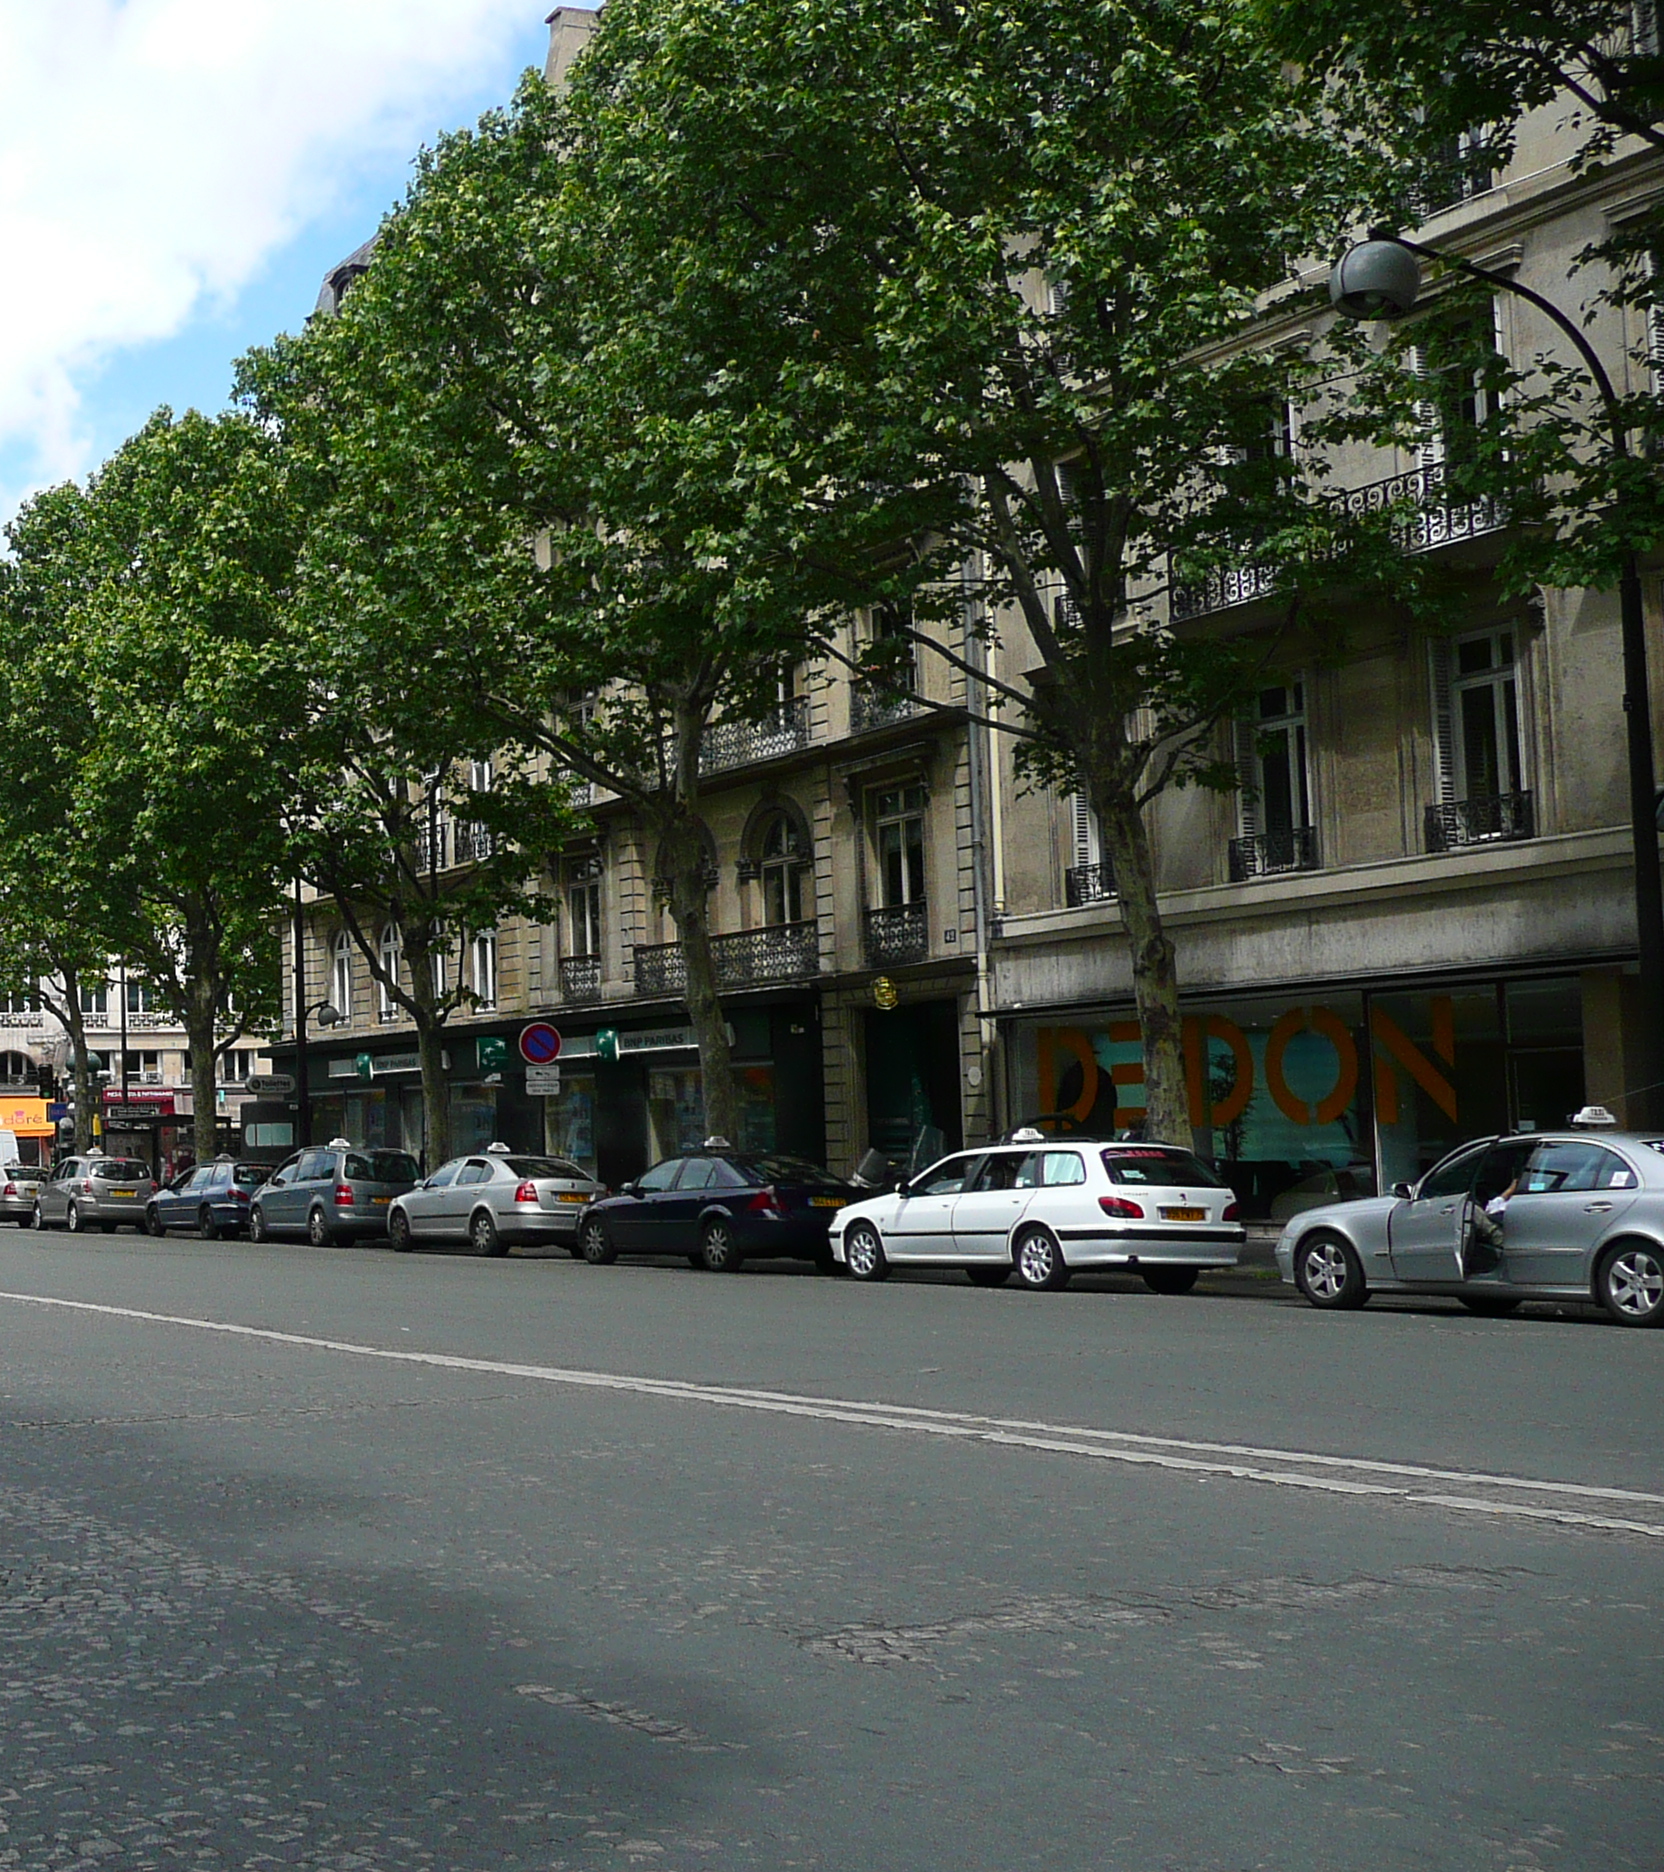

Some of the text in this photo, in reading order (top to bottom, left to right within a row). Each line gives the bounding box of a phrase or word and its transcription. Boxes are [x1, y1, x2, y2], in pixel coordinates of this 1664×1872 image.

[624, 1033, 683, 1047] BNP PARIBAS
[1038, 996, 1458, 1130] DEDON
